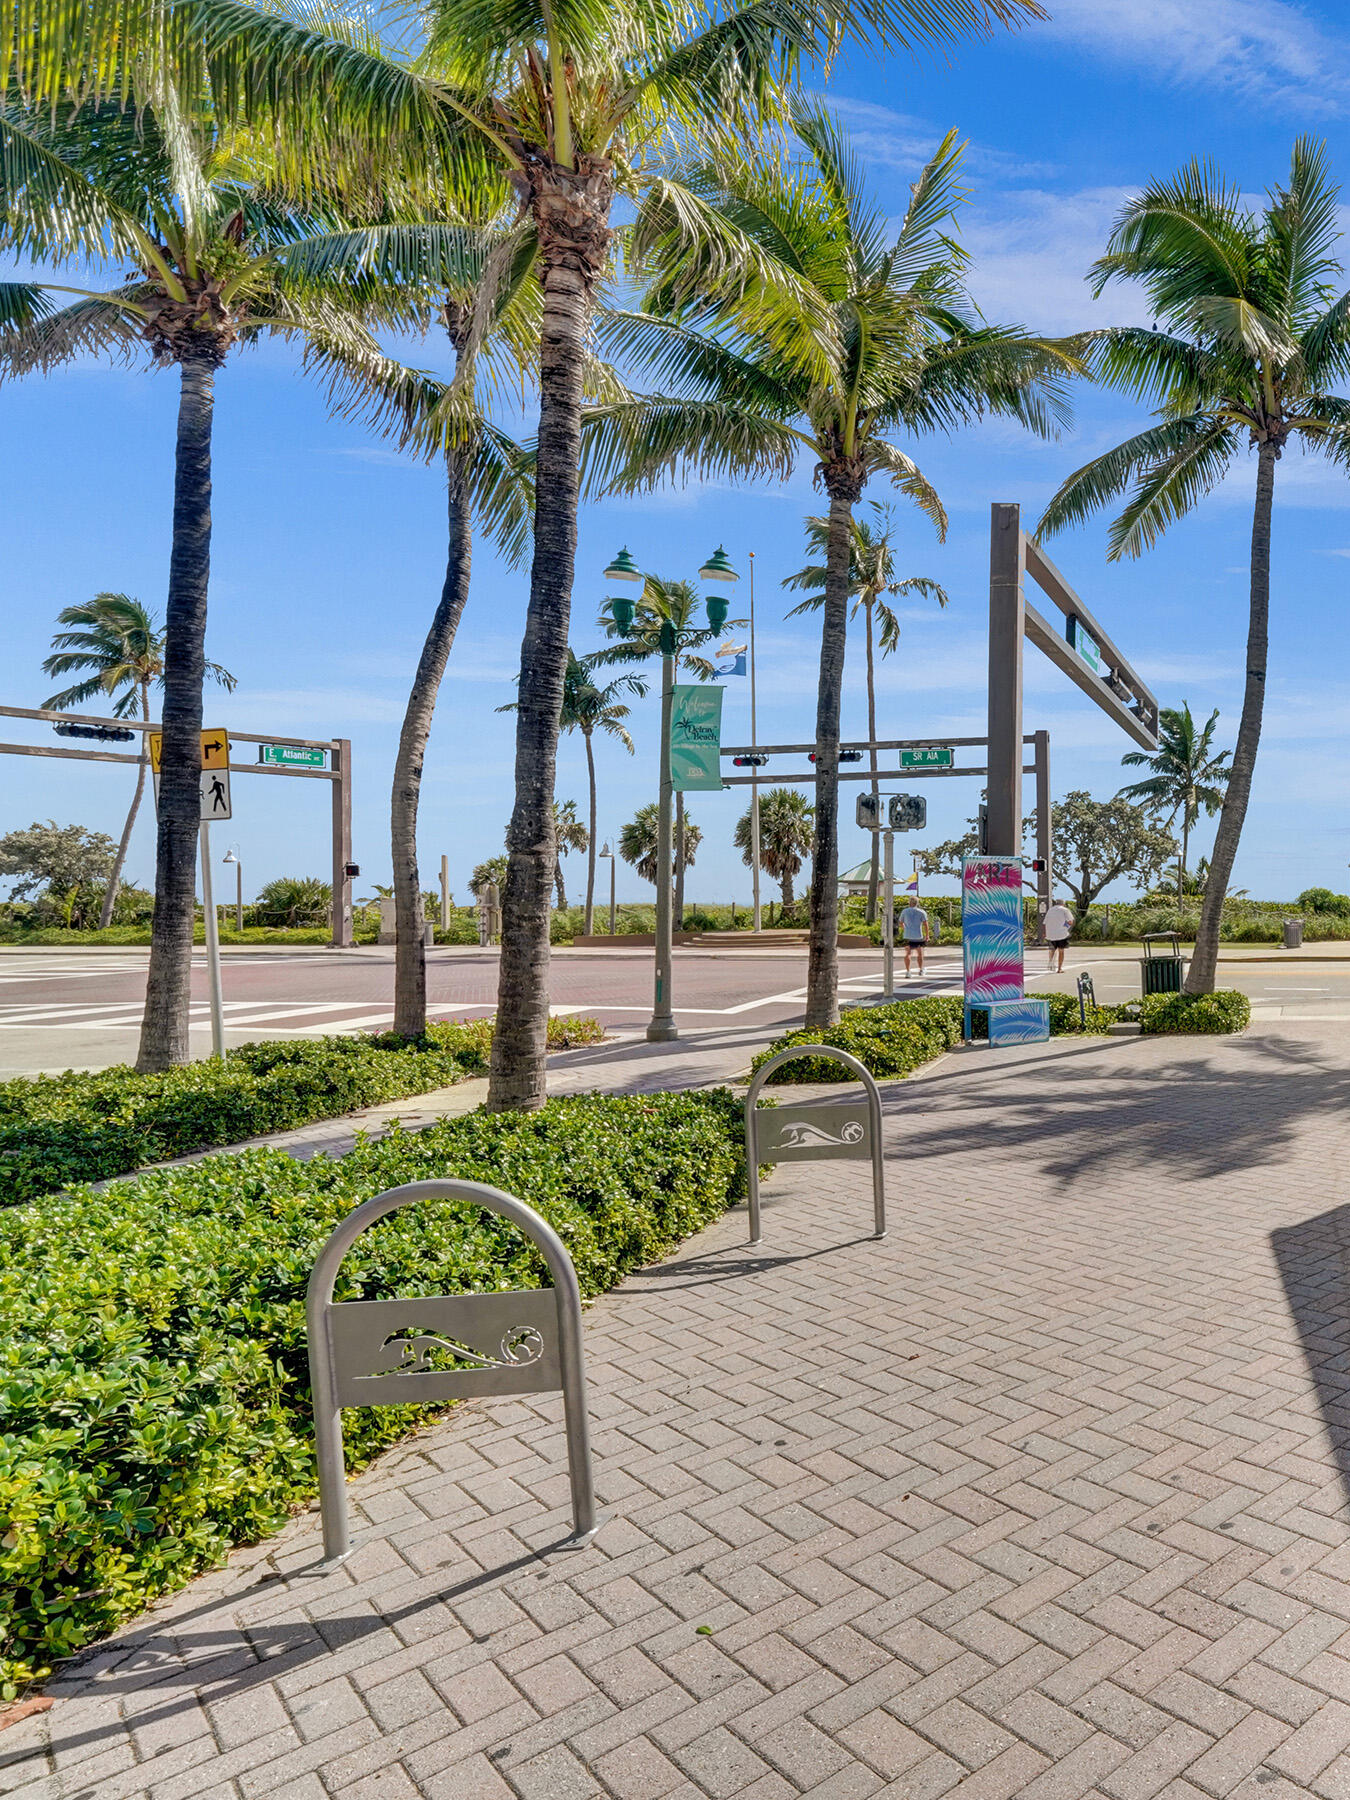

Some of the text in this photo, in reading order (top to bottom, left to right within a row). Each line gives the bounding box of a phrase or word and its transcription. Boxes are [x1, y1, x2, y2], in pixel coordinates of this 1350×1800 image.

[688, 725, 713, 734] Delray
[692, 732, 719, 742] Beach
[282, 750, 312, 760] Atlantic
[913, 752, 923, 761] SR
[973, 862, 1013, 884] ART
